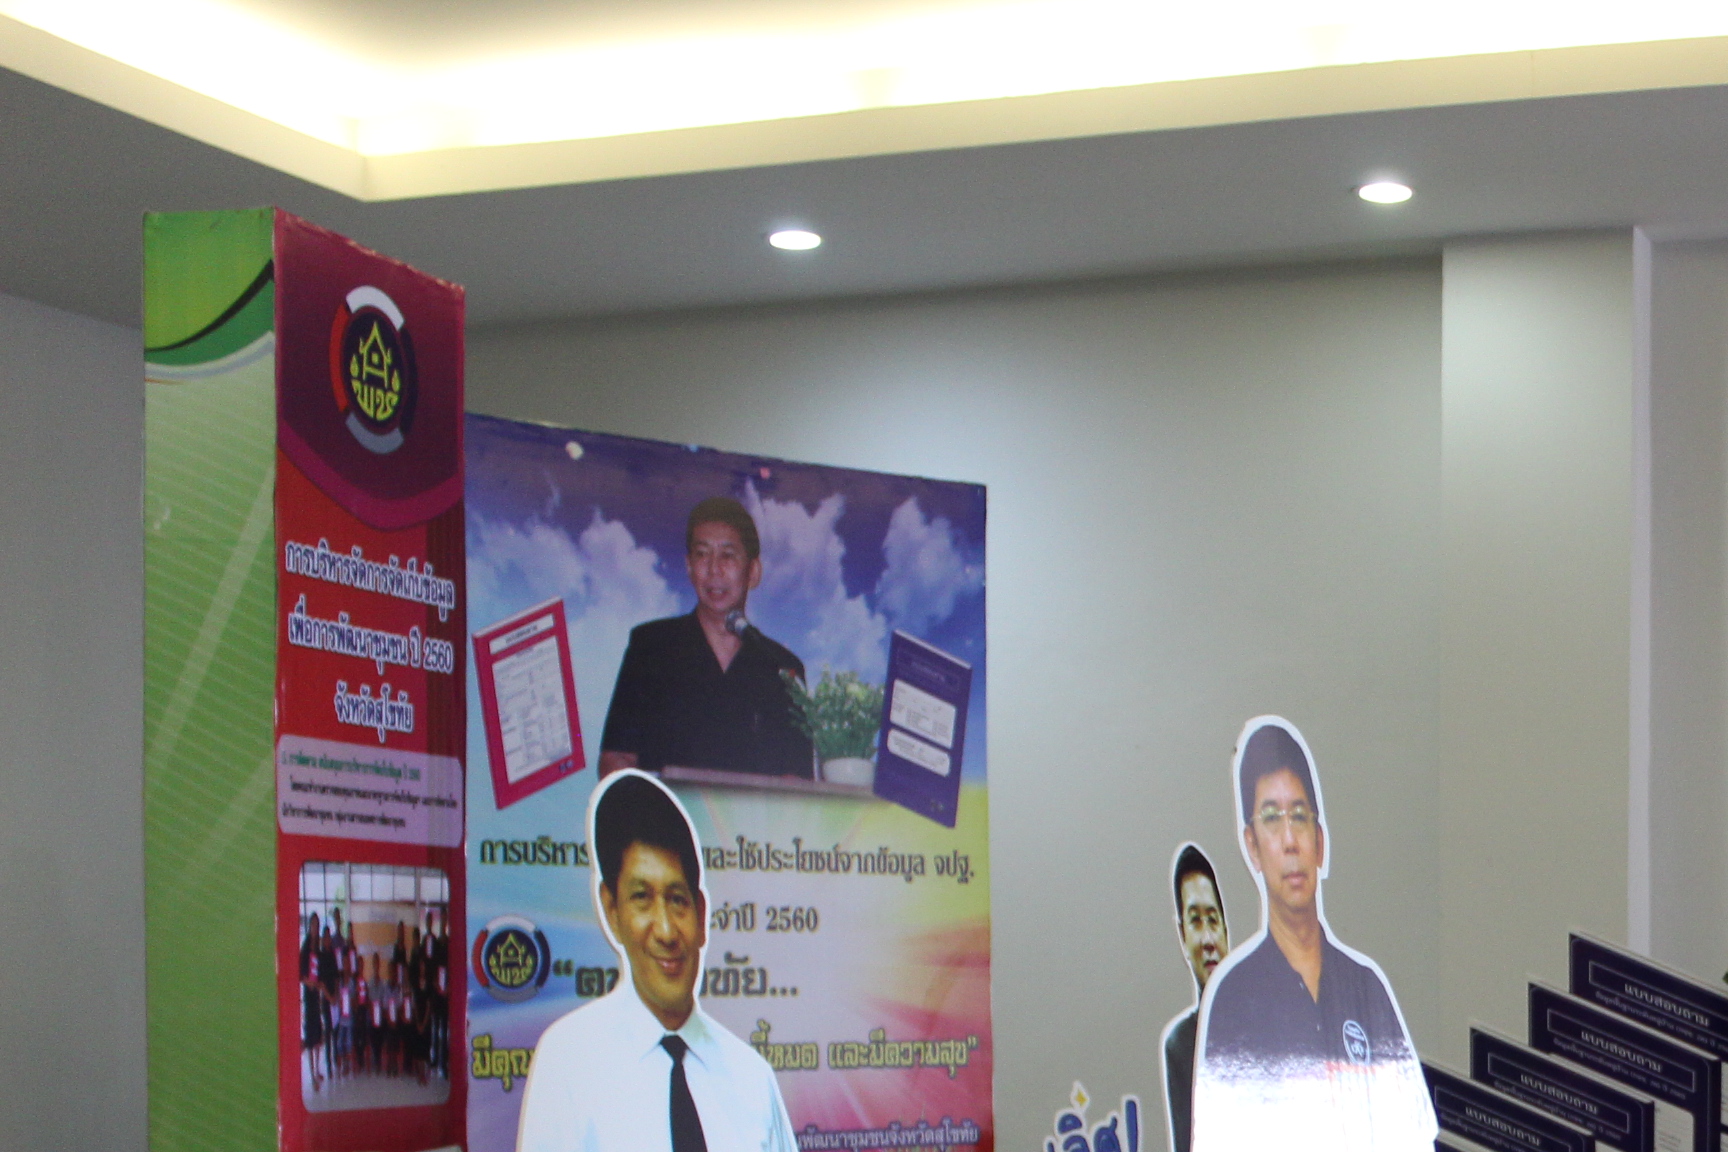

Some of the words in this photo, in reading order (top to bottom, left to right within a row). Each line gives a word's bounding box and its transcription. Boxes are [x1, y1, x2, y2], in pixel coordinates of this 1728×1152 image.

[286, 538, 455, 622] การบริหารจัดการจัดเก็บข้อมูล
[289, 594, 408, 675] เพื่อการพัฒนาชุมชน
[409, 626, 421, 667] ปี
[423, 637, 454, 674] 2560
[335, 680, 414, 743] จังหวัดสุโขทัย
[934, 849, 974, 884] จปฐ.
[765, 905, 819, 933] 2560
[1624, 982, 1710, 1028] แบบสอบถาม
[1580, 1030, 1663, 1073] แบบสอบถาม
[1520, 1073, 1599, 1115] แบบสอบถาม
[1465, 1106, 1541, 1147] แบบสอบถาม
